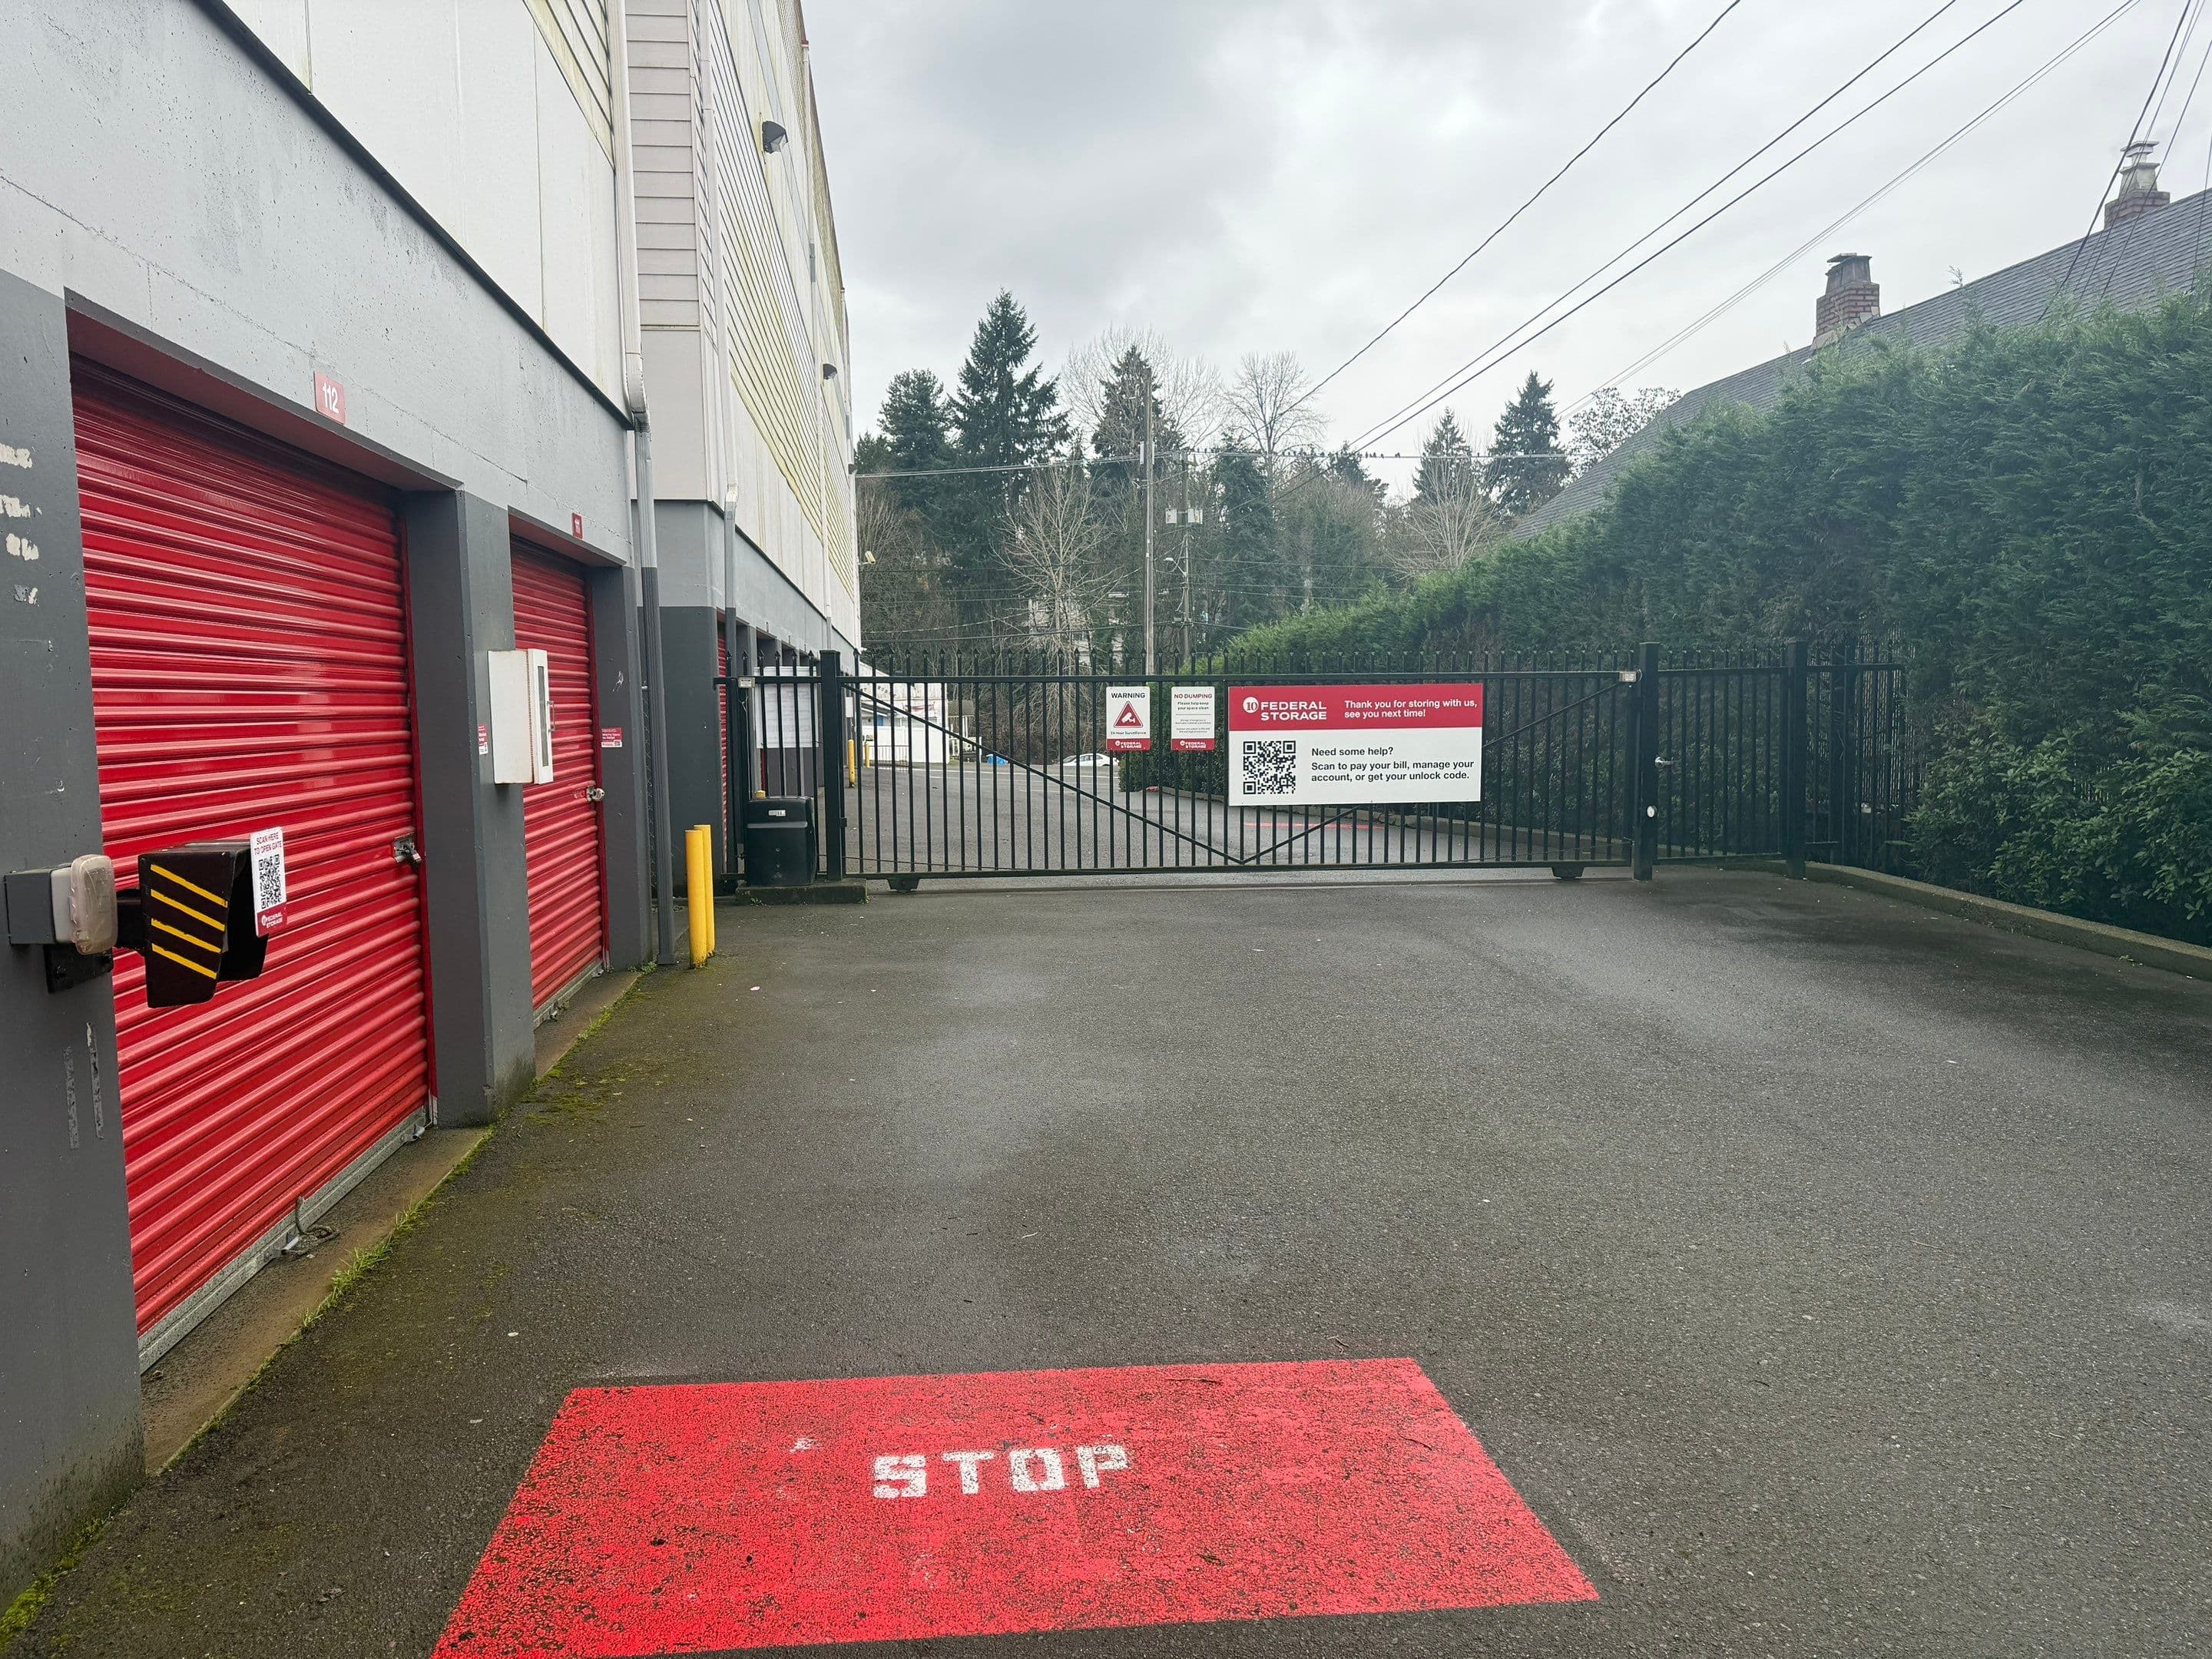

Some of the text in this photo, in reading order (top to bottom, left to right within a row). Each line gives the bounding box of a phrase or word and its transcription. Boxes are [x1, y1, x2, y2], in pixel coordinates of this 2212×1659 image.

[323, 382, 339, 414] 112
[1260, 700, 1326, 710] FEDERAL
[1344, 698, 1477, 710] Thank you for storing with us,
[1260, 711, 1327, 720] STORAGE
[1363, 710, 1379, 719] you
[1403, 709, 1426, 717] time!
[1311, 747, 1336, 757] Need
[1368, 747, 1394, 757] help?
[1311, 760, 1475, 772] Scan to pay your bill, manage your
[1311, 773, 1353, 783] account,
[1368, 773, 1383, 783] get
[1386, 773, 1406, 782] your
[1409, 771, 1441, 780] unlock
[1443, 770, 1469, 780] code.
[257, 832, 279, 845] SCAN HERE
[254, 840, 282, 855] TO OPEN GATE
[873, 1444, 1132, 1498] STOP
